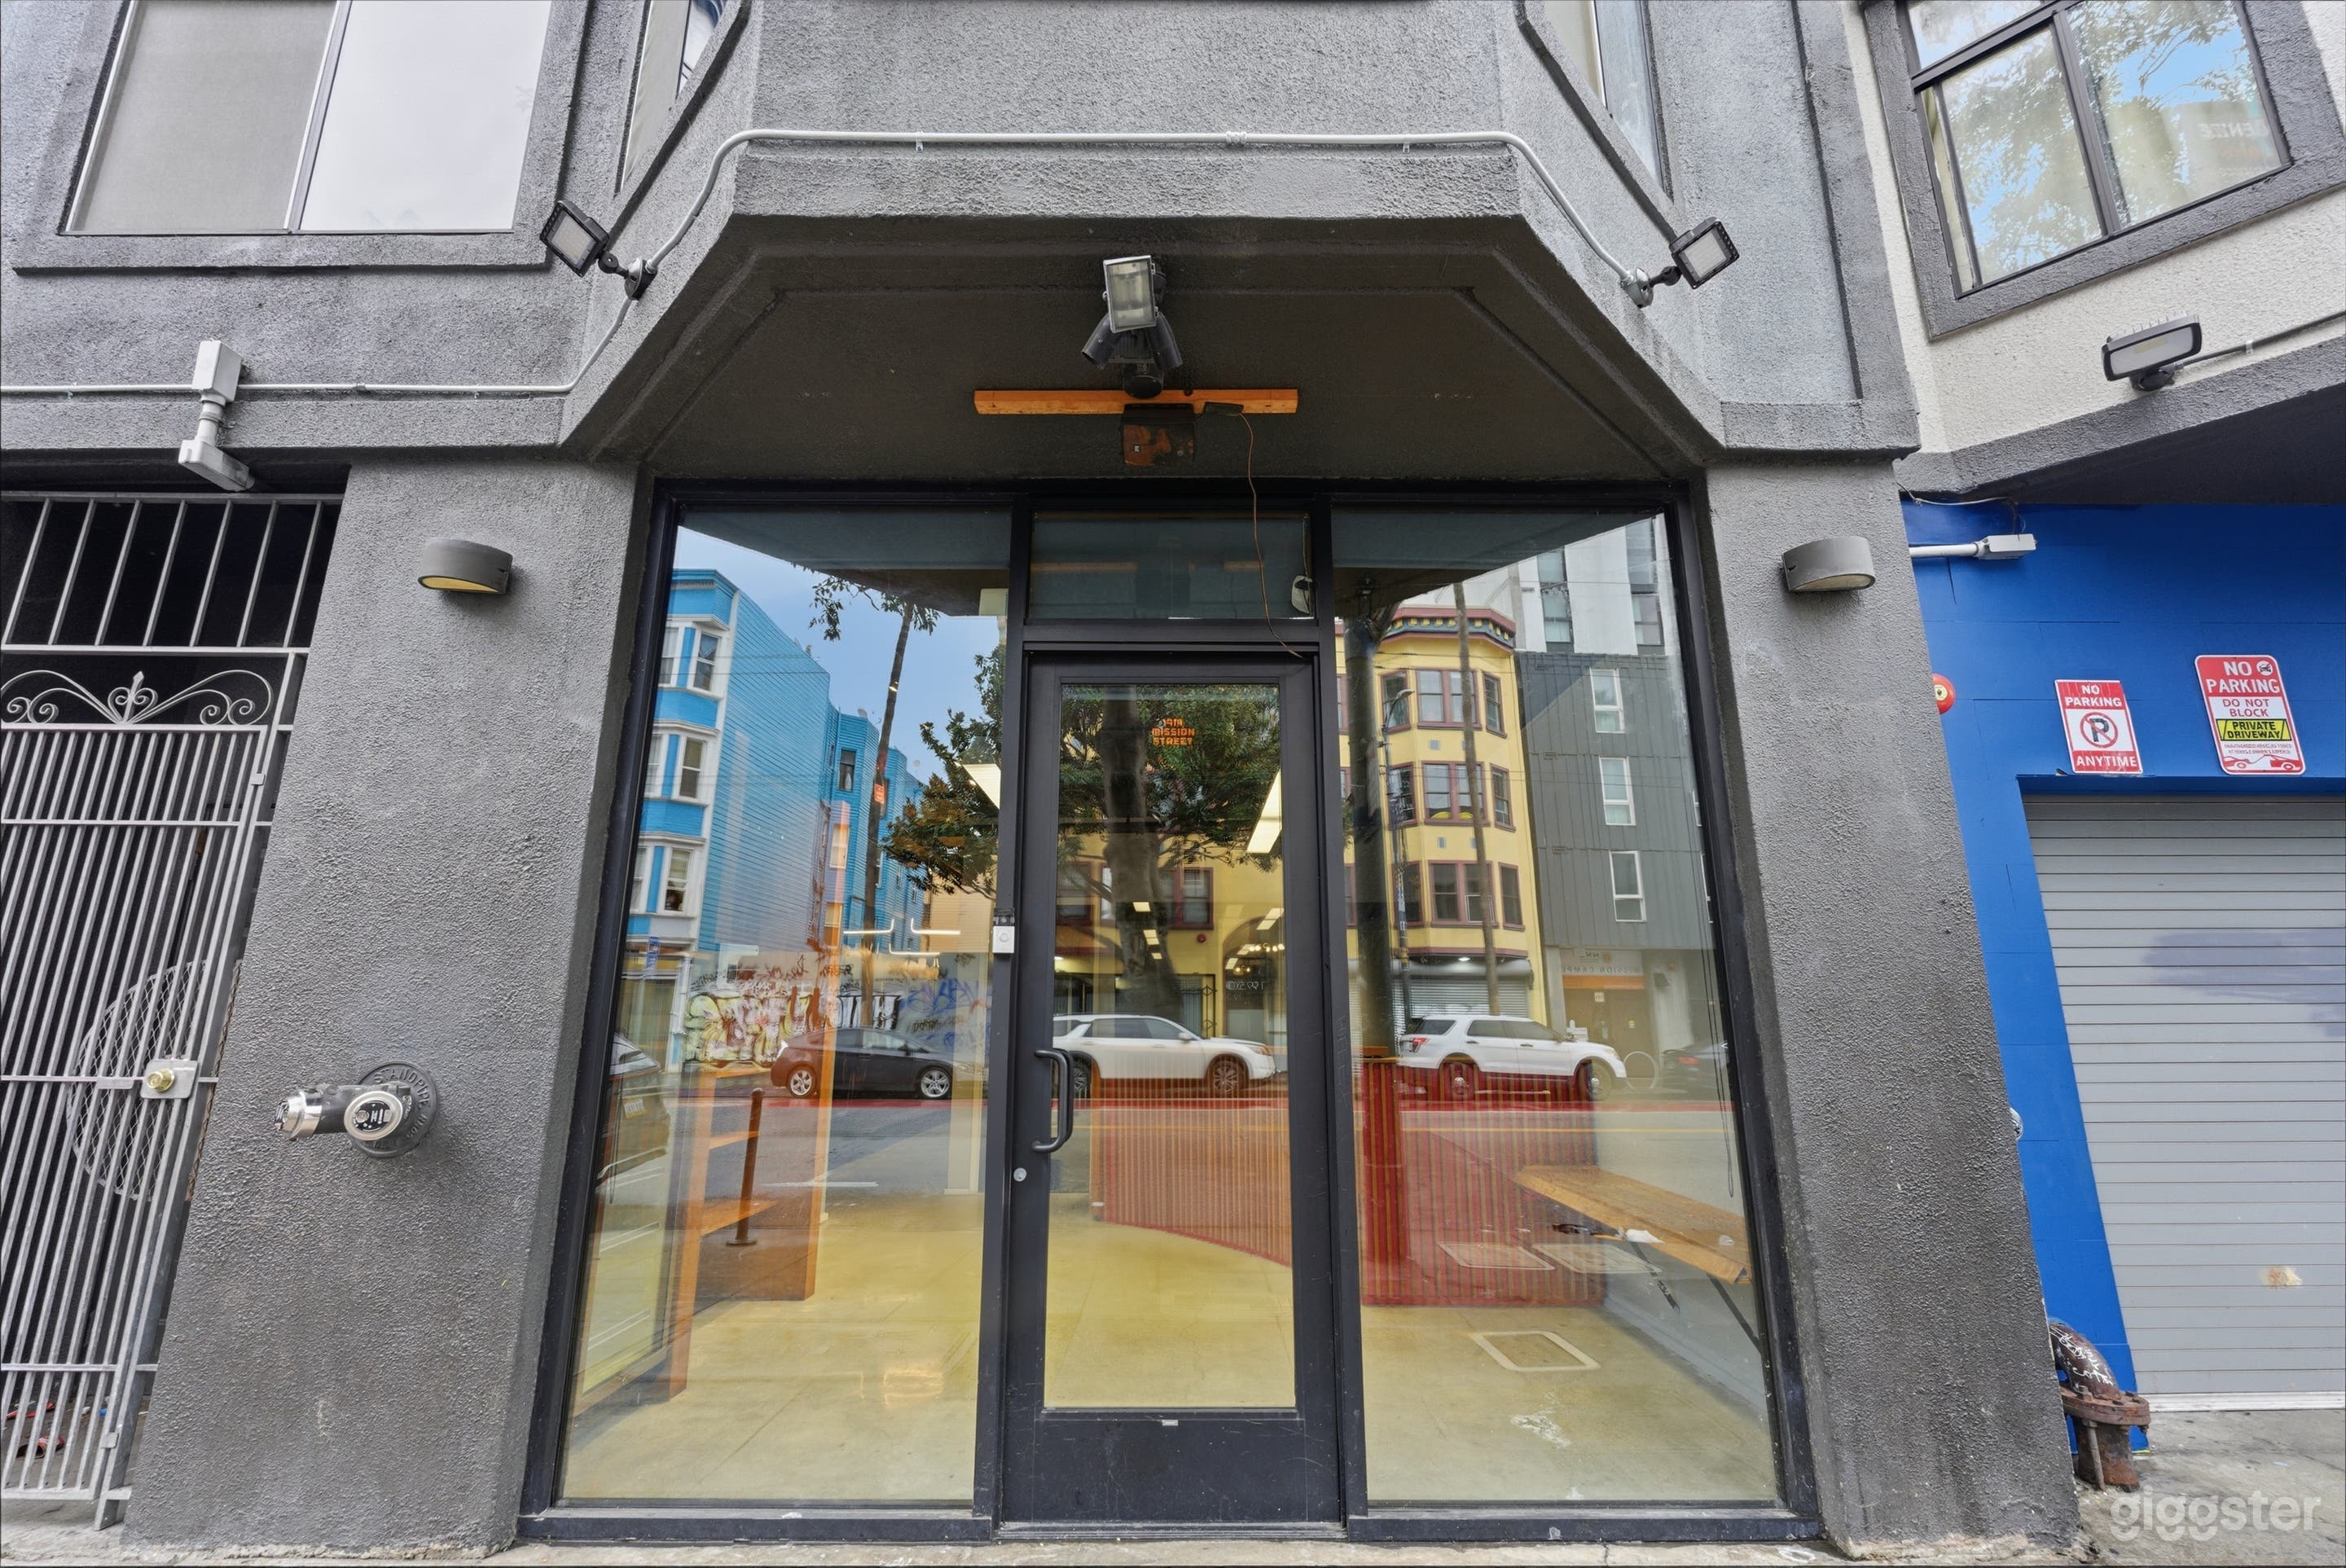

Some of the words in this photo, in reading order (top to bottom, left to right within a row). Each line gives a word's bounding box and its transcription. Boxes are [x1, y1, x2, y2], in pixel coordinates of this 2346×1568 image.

[2223, 661, 2252, 677] NO
[2081, 684, 2101, 695] NO
[2206, 678, 2281, 694] PARKING
[2065, 696, 2123, 708] PARKING
[2222, 698, 2241, 709] DO
[2246, 698, 2270, 708] NOT
[2229, 708, 2269, 718] BLOCK
[1151, 727, 1196, 736] MISSION
[2232, 721, 2276, 731] PRIVATE
[2226, 730, 2281, 740] DRIVEWAY
[1152, 737, 1193, 746] STREET
[2076, 755, 2137, 767] ANYTIME
[373, 1067, 431, 1108] STANDPIPE
